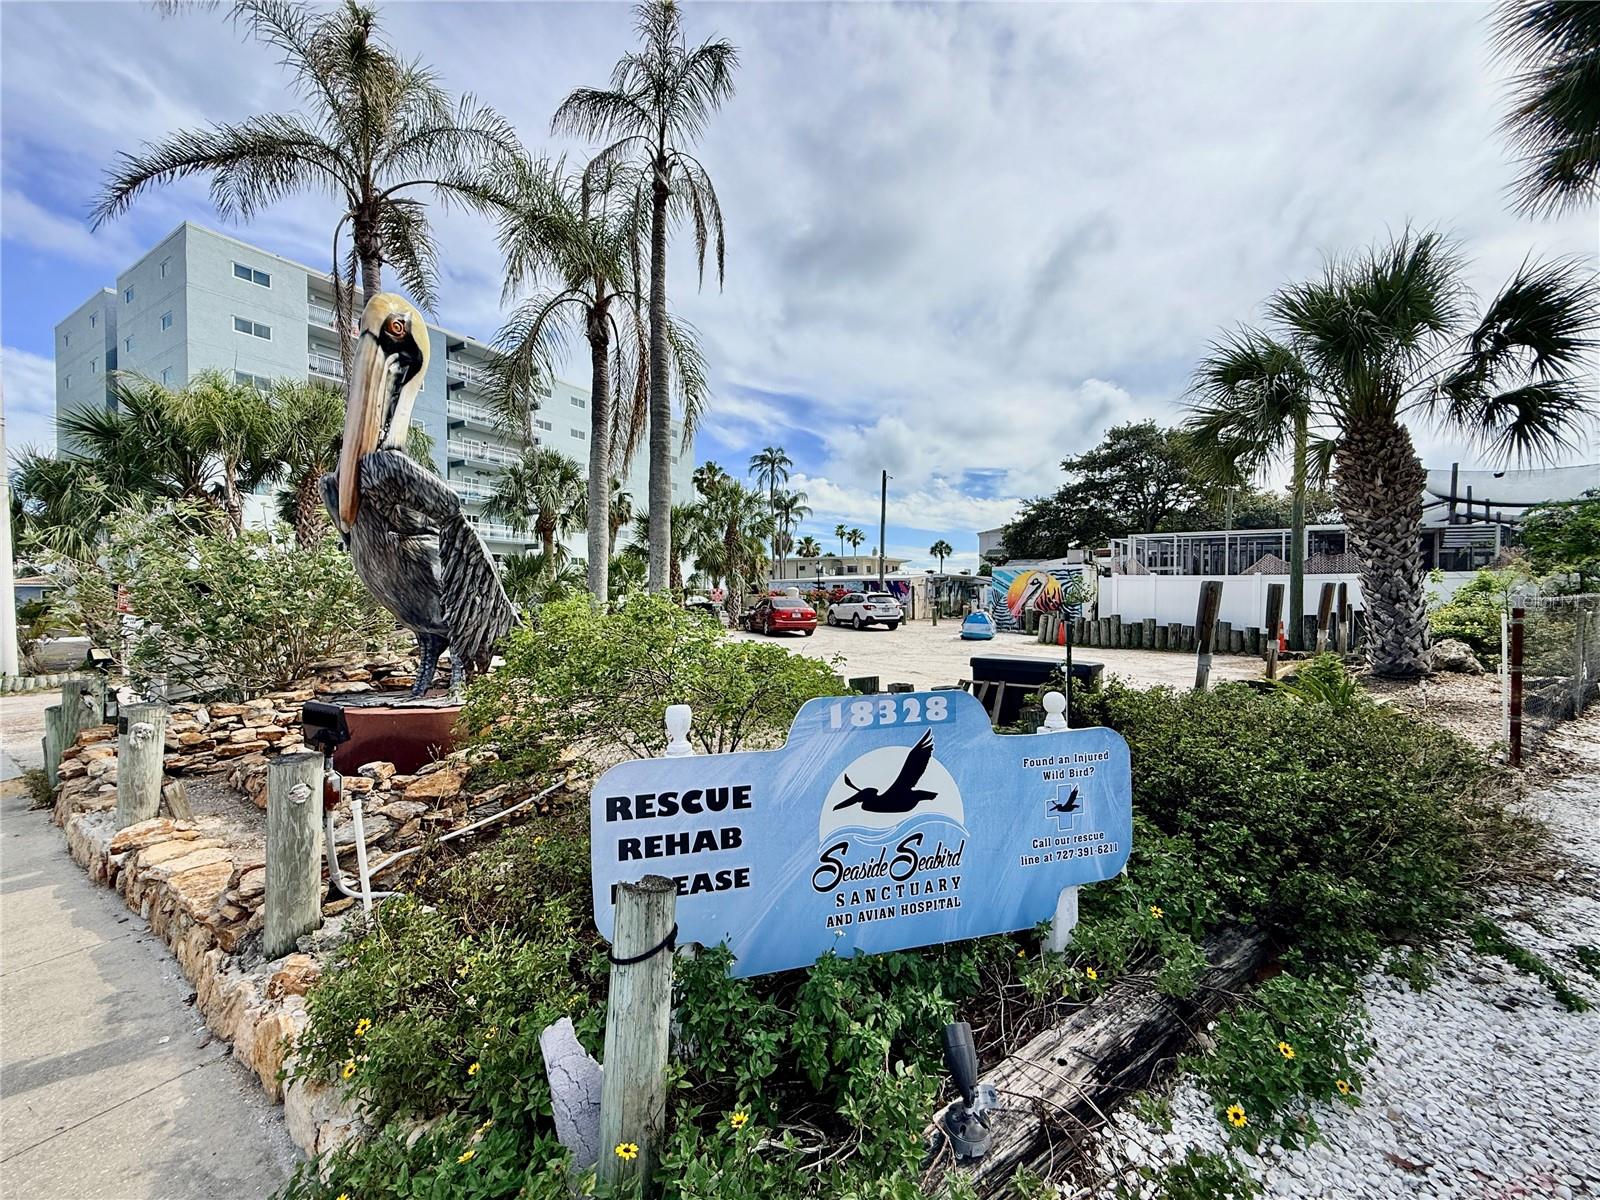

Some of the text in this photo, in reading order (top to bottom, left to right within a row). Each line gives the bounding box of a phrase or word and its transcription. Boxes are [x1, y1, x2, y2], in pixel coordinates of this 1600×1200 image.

[830, 697, 949, 729] 18328
[1023, 751, 1109, 768] Found an Injured
[1043, 767, 1095, 781] Wild Bird?
[605, 785, 752, 823] RESCUE
[618, 827, 743, 862] REHAB
[1021, 843, 1118, 866] line at 727-391-6211
[1032, 832, 1105, 850] Call our rescue
[812, 832, 965, 892] Seaside Seabird
[611, 867, 751, 905] EASE
[836, 876, 961, 907] SANCTUARY
[826, 896, 961, 928] AND AVIAN HOSPITAL
